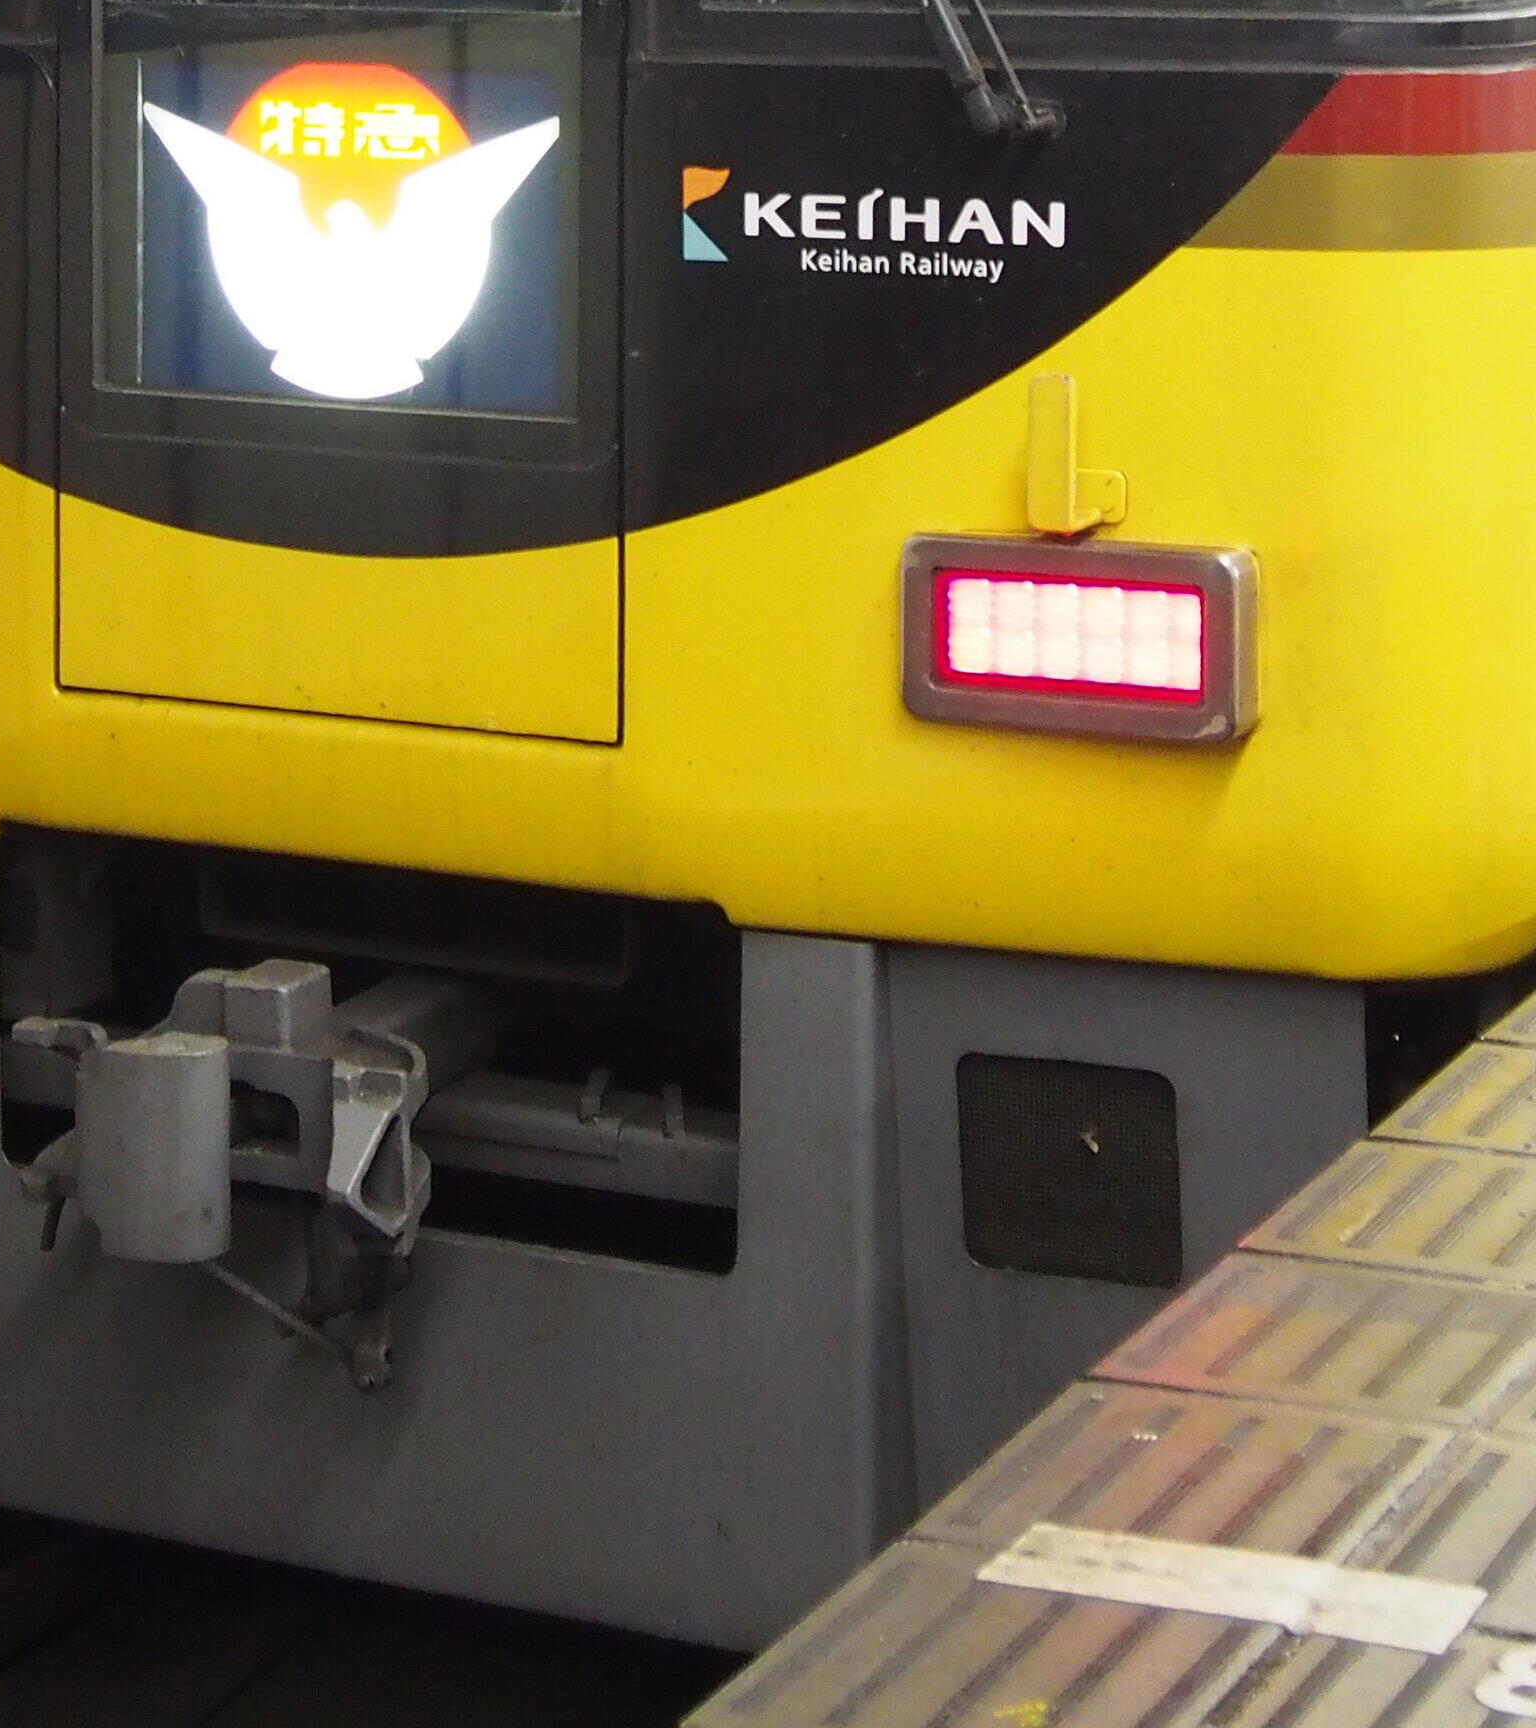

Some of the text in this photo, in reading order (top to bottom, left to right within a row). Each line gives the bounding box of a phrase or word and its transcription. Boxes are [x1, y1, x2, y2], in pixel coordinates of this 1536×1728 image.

[259, 100, 441, 159] 特急
[743, 187, 1066, 248] KEIHAN
[800, 247, 1005, 284] Keihan Railway
